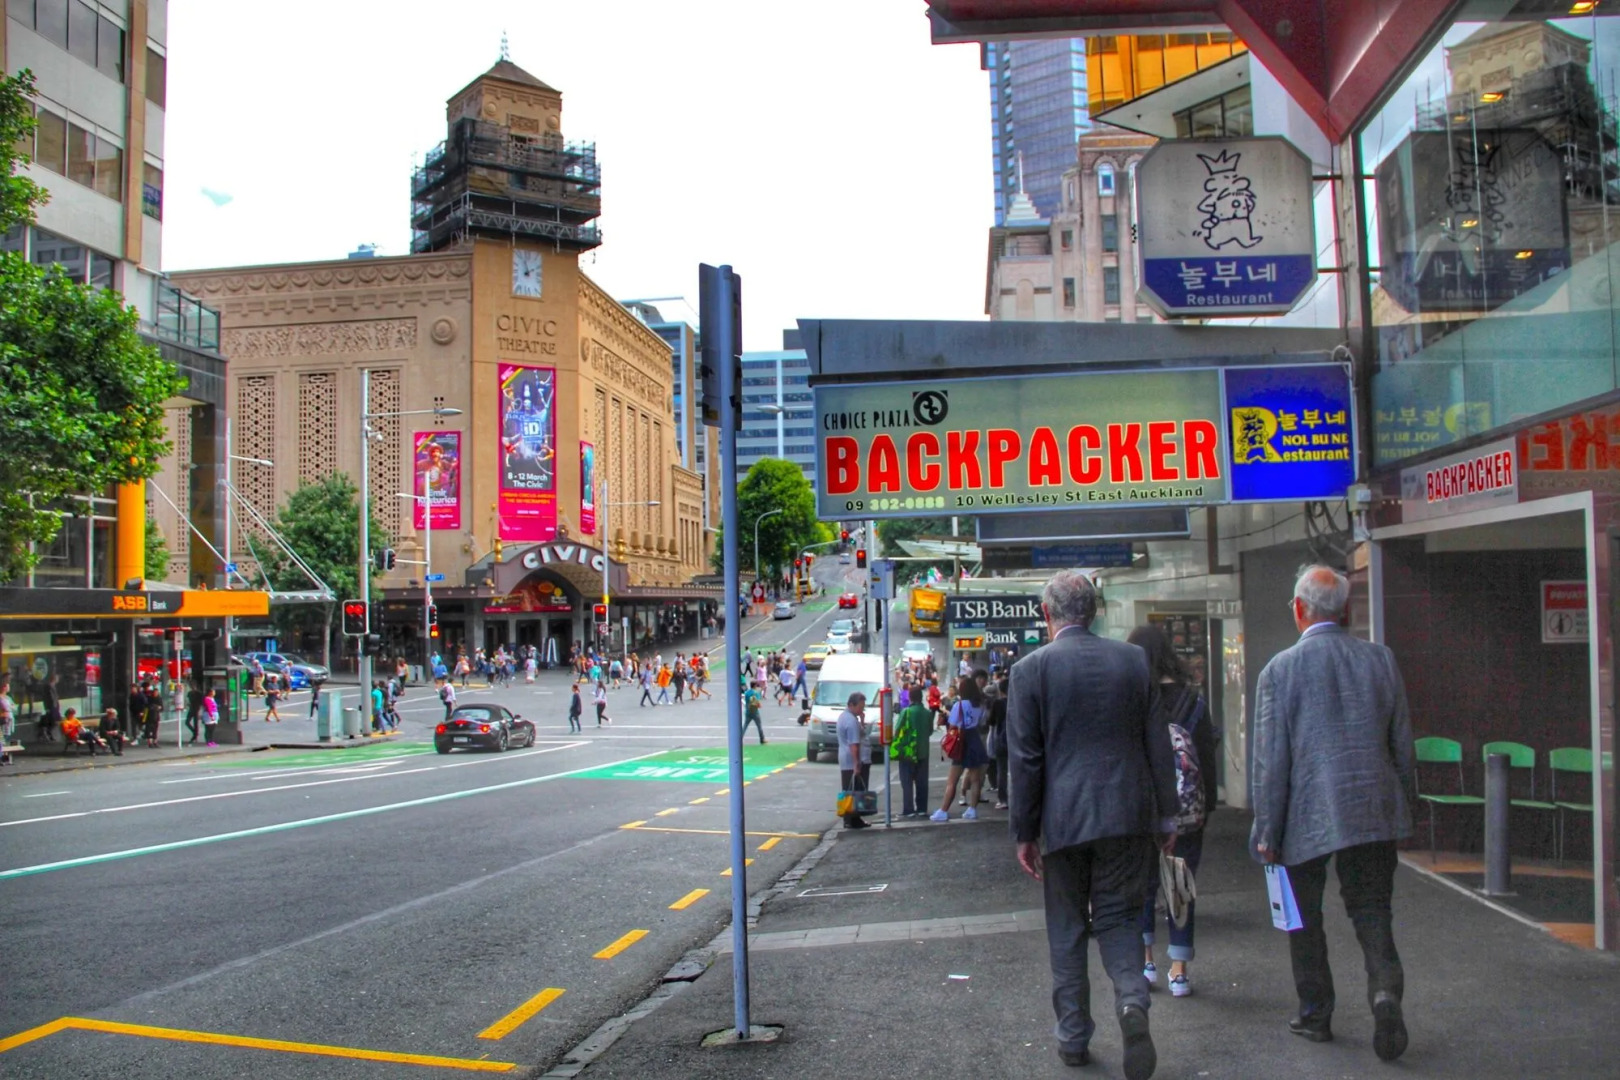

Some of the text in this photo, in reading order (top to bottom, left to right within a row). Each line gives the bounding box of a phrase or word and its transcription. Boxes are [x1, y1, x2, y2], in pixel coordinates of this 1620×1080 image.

[1177, 261, 1276, 290] 놀부네
[1186, 292, 1273, 305] Restaurant
[496, 314, 557, 337] CIVIC
[497, 337, 557, 355] THEATRE
[824, 409, 910, 430] CHOICE PLAZA
[1277, 409, 1346, 431] 놀부네
[1282, 433, 1349, 446] NOL BU NE
[825, 419, 1221, 496] BACKPACKER
[507, 472, 513, 480] 8
[526, 473, 548, 482] March
[526, 480, 543, 488] Civic
[1426, 450, 1513, 503] BACKPACKER
[846, 486, 1204, 511] 09 302-0888 10 Wellesley St East Auckland
[523, 544, 605, 571] CIVIC
[113, 596, 147, 610] ASB
[950, 600, 1040, 619] TSB Bank
[985, 631, 1018, 644] Bank
